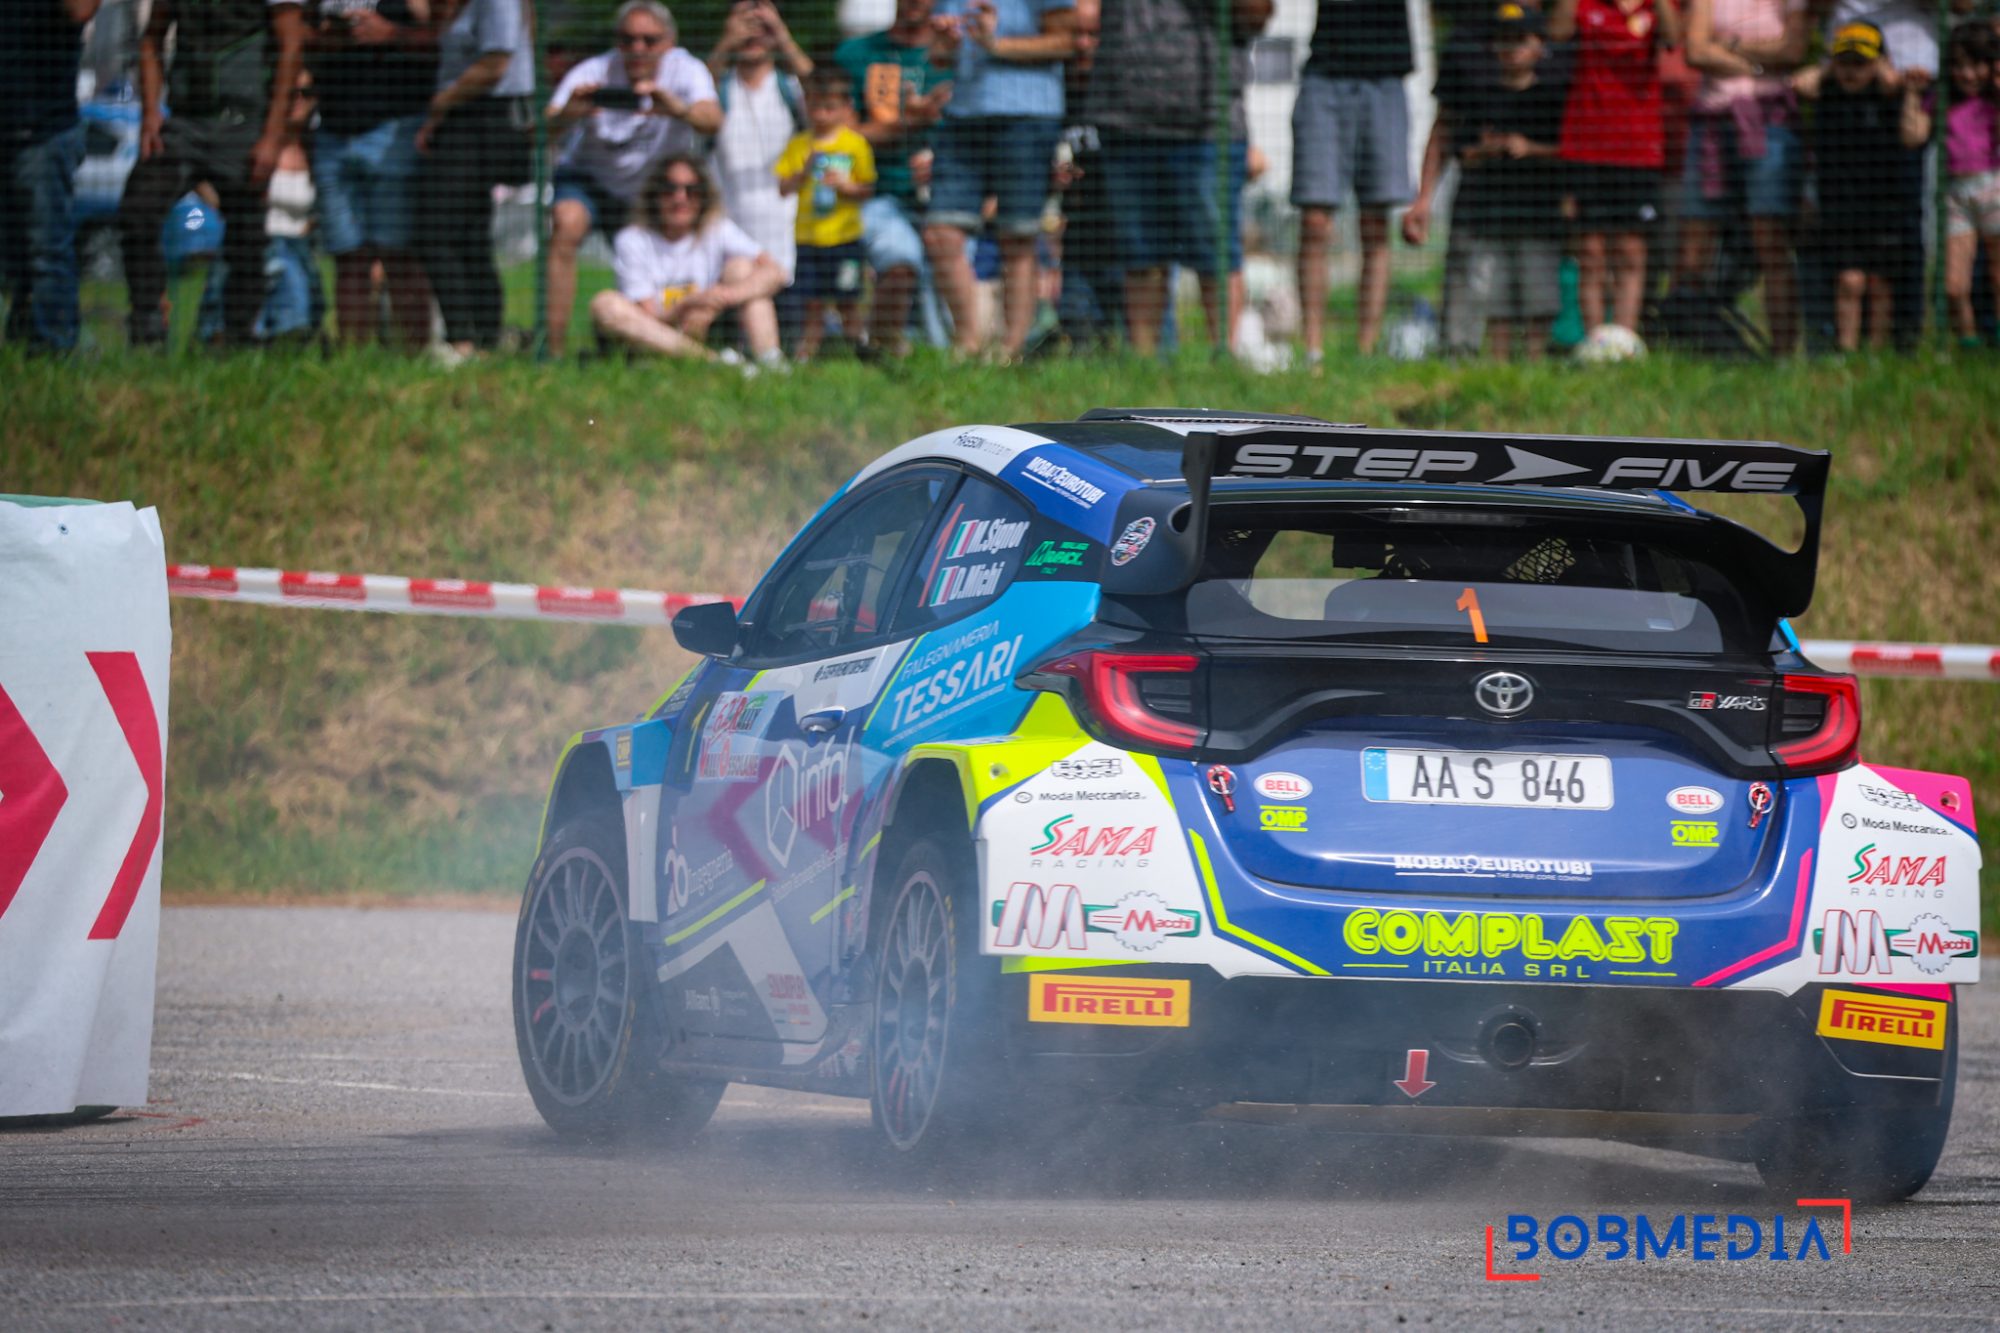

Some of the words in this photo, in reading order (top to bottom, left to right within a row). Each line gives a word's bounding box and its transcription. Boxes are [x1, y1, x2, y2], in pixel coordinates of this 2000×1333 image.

[1230, 444, 1479, 479] STEP
[1600, 456, 1799, 491] FIVE
[1456, 587, 1489, 643] 1
[891, 635, 1024, 731] TESSARI
[1265, 779, 1303, 792] BELL
[1411, 755, 1459, 798] AA
[1473, 757, 1494, 800] S
[1521, 759, 1585, 804] 846
[1038, 791, 1073, 801] Moda
[1676, 794, 1714, 806] BELL
[1259, 809, 1308, 827] OMP
[1862, 816, 1890, 830] Moda
[1030, 812, 1159, 856] SAMA
[1671, 824, 1719, 842] OMP
[1030, 859, 1149, 869] RACING
[1393, 856, 1459, 869] MOBA
[1482, 857, 1593, 876] EUROTUBI
[1847, 842, 1947, 886] SAMA
[1850, 887, 1945, 899] RACING
[1122, 909, 1192, 933] Macchi
[1343, 908, 1679, 964] COMPLAST
[1917, 931, 1971, 954] Macchi
[1423, 961, 1505, 976] ITALIA
[1042, 982, 1176, 1017] PIRELLI
[1830, 998, 1935, 1039] PIRELLI
